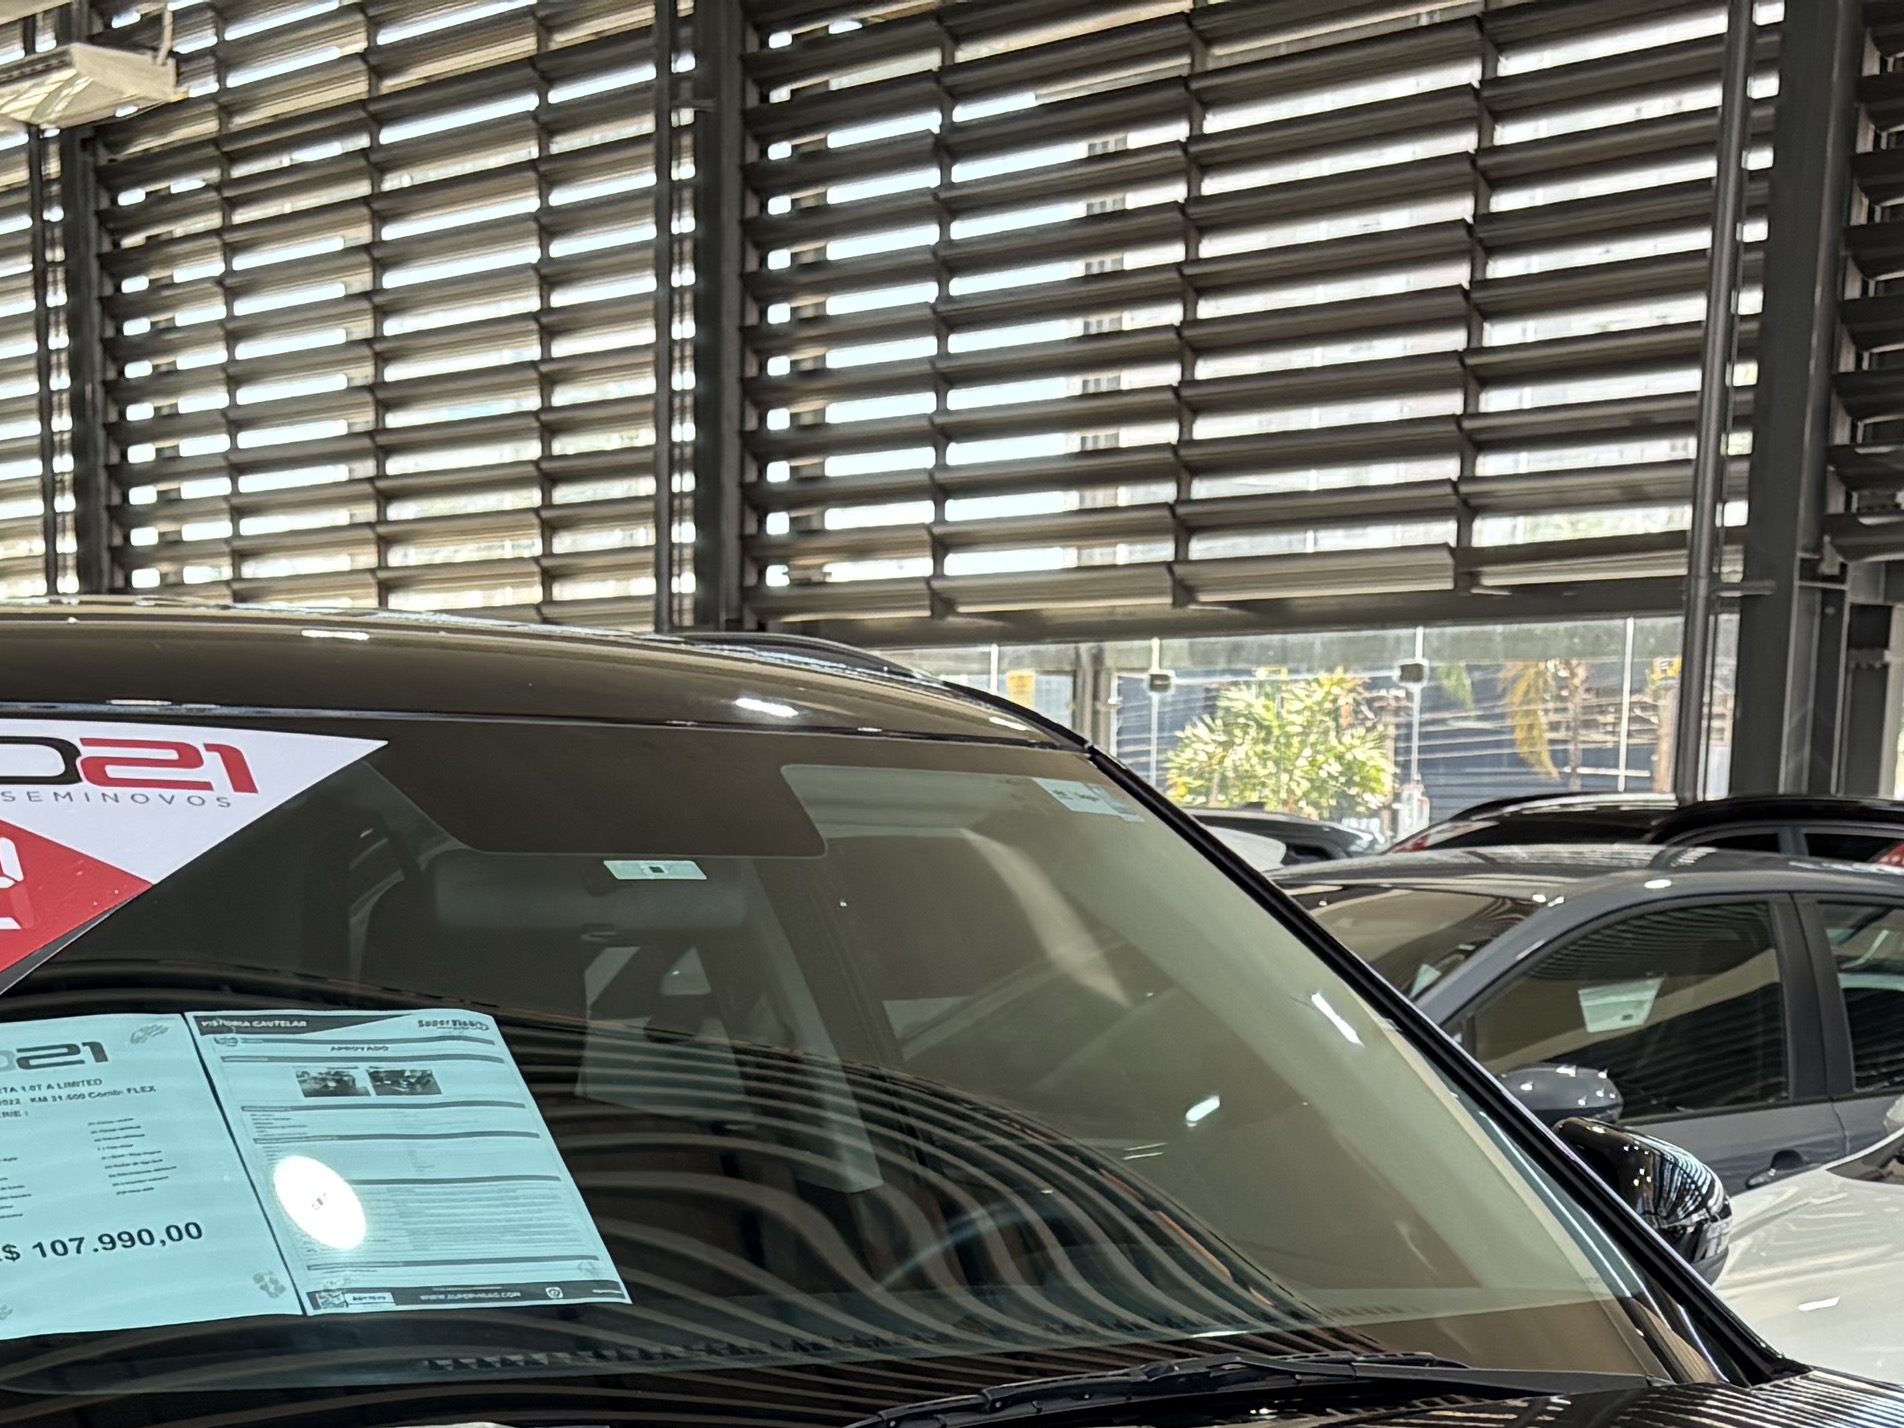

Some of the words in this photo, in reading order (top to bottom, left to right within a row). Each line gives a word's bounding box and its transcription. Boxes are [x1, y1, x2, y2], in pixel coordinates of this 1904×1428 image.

[0, 790, 232, 808] SEMINOVOS
[56, 1077, 103, 1090] LIMITED
[126, 1085, 157, 1094] FLEX
[32, 1220, 204, 1258] 107.990,00
